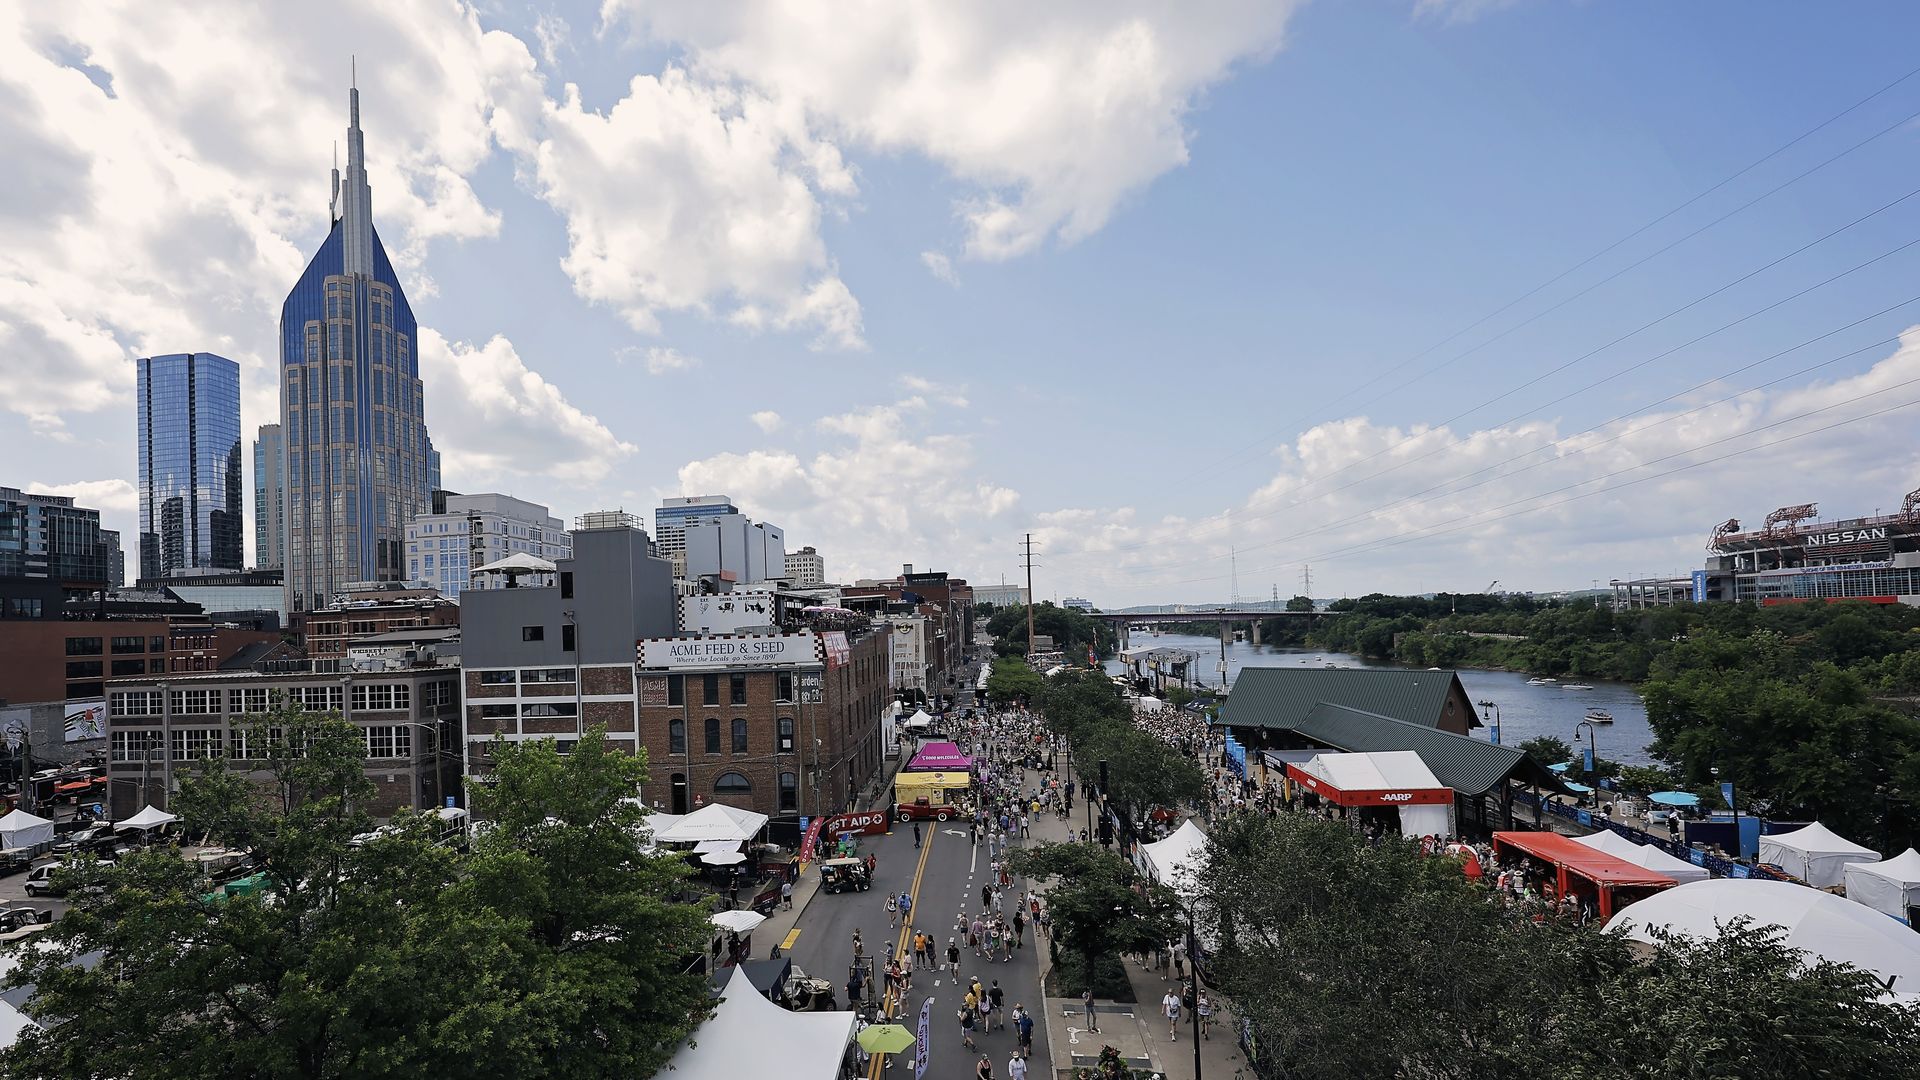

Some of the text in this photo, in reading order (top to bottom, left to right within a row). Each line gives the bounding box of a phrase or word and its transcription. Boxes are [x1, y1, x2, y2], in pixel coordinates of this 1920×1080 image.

[1807, 527, 1886, 546] NISSAN
[669, 641, 785, 657] ACME FEED & SEED
[643, 680, 665, 691] ACME
[793, 675, 819, 687] Barden
[1380, 793, 1413, 802] AARP
[850, 816, 871, 827] AID
[801, 826, 817, 863] FIRST AID
